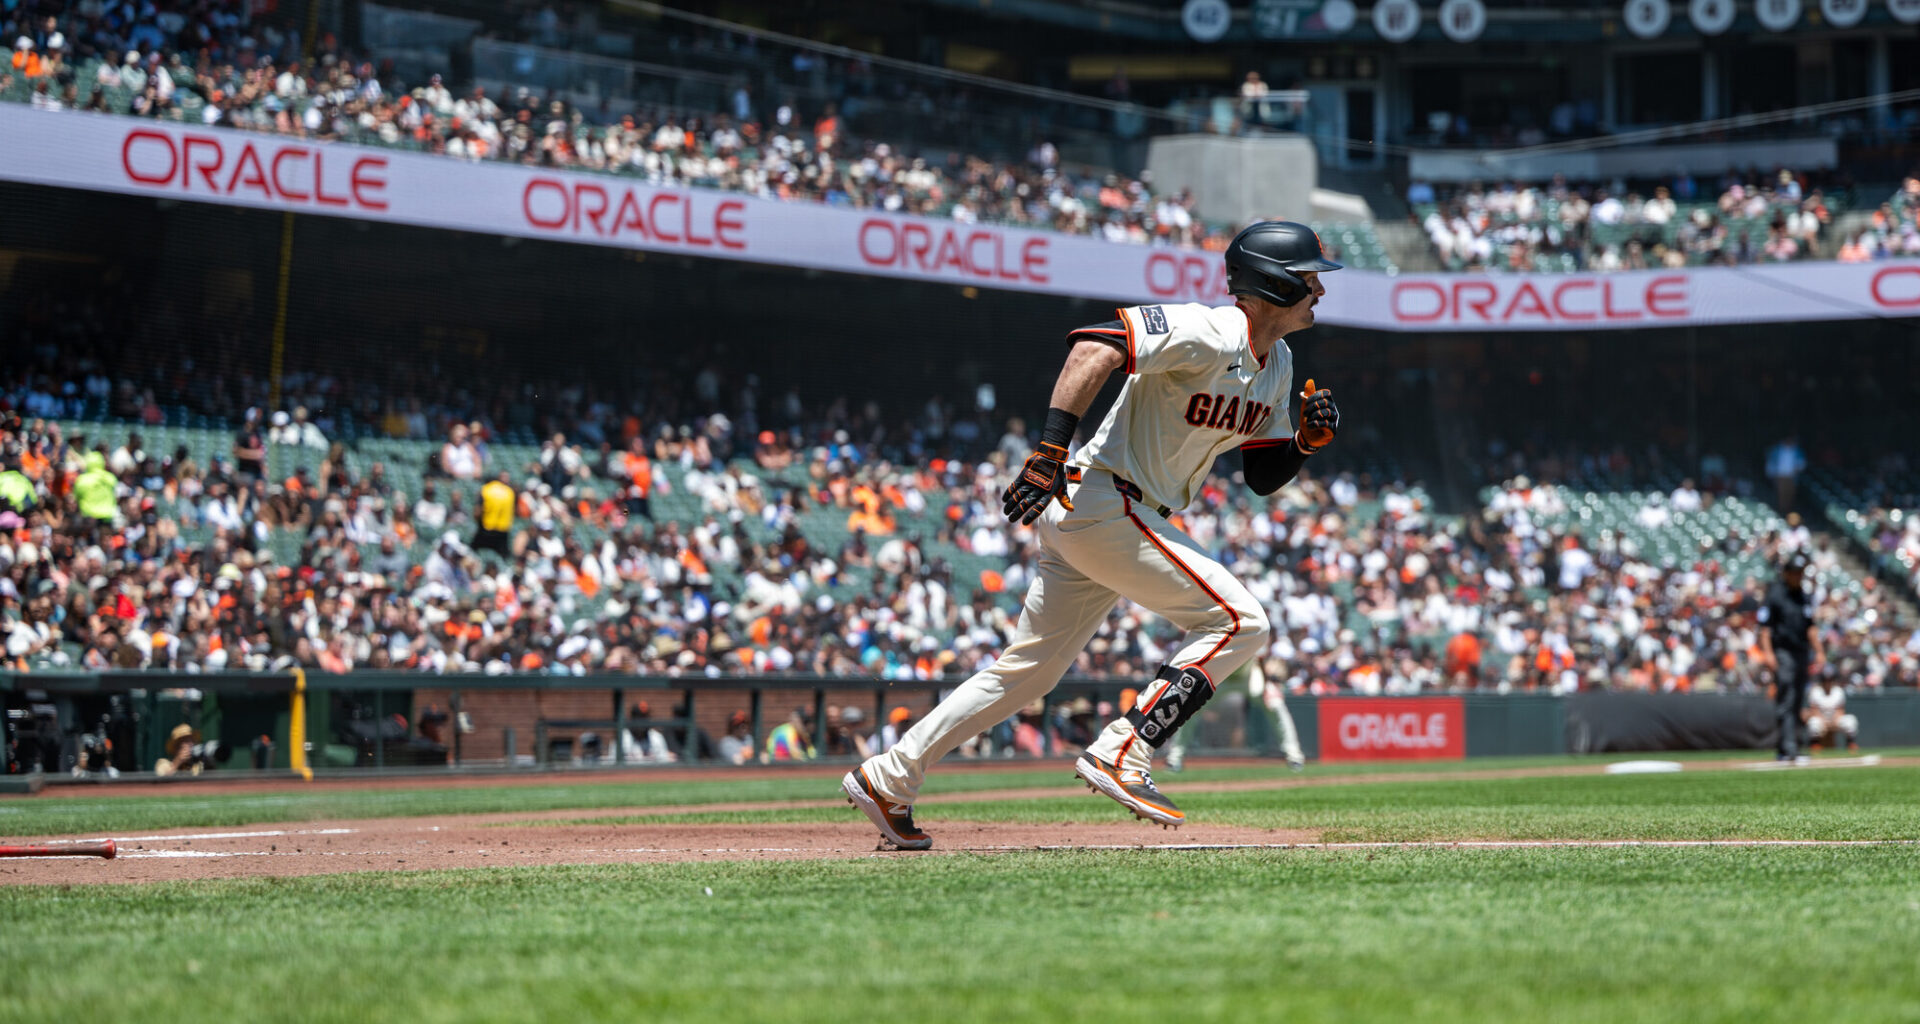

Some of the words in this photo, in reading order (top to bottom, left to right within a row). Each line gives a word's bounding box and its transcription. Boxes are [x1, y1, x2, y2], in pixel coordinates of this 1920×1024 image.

[121, 129, 389, 211] ORACLE
[523, 177, 747, 250] ORACLE
[859, 218, 1050, 283] ORACLE
[1392, 275, 1690, 323] ORACLE
[1184, 392, 1272, 437] GIANT
[1339, 712, 1447, 750] ORACLE
